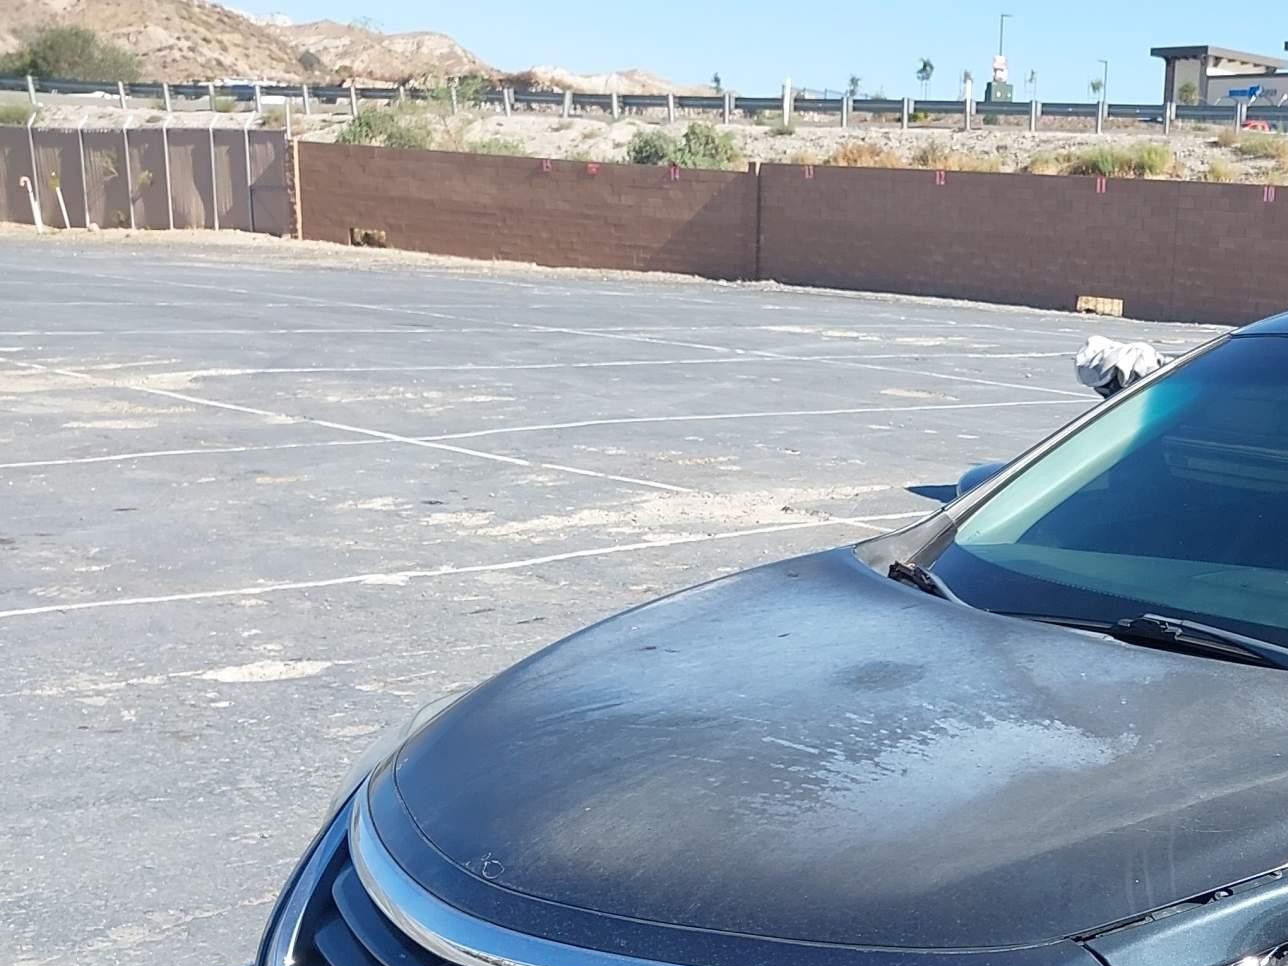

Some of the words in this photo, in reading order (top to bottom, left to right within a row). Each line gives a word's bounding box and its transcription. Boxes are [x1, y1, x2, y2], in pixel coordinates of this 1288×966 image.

[935, 170, 945, 185] 12
[1096, 176, 1106, 193] 11
[1263, 185, 1275, 202] 10
